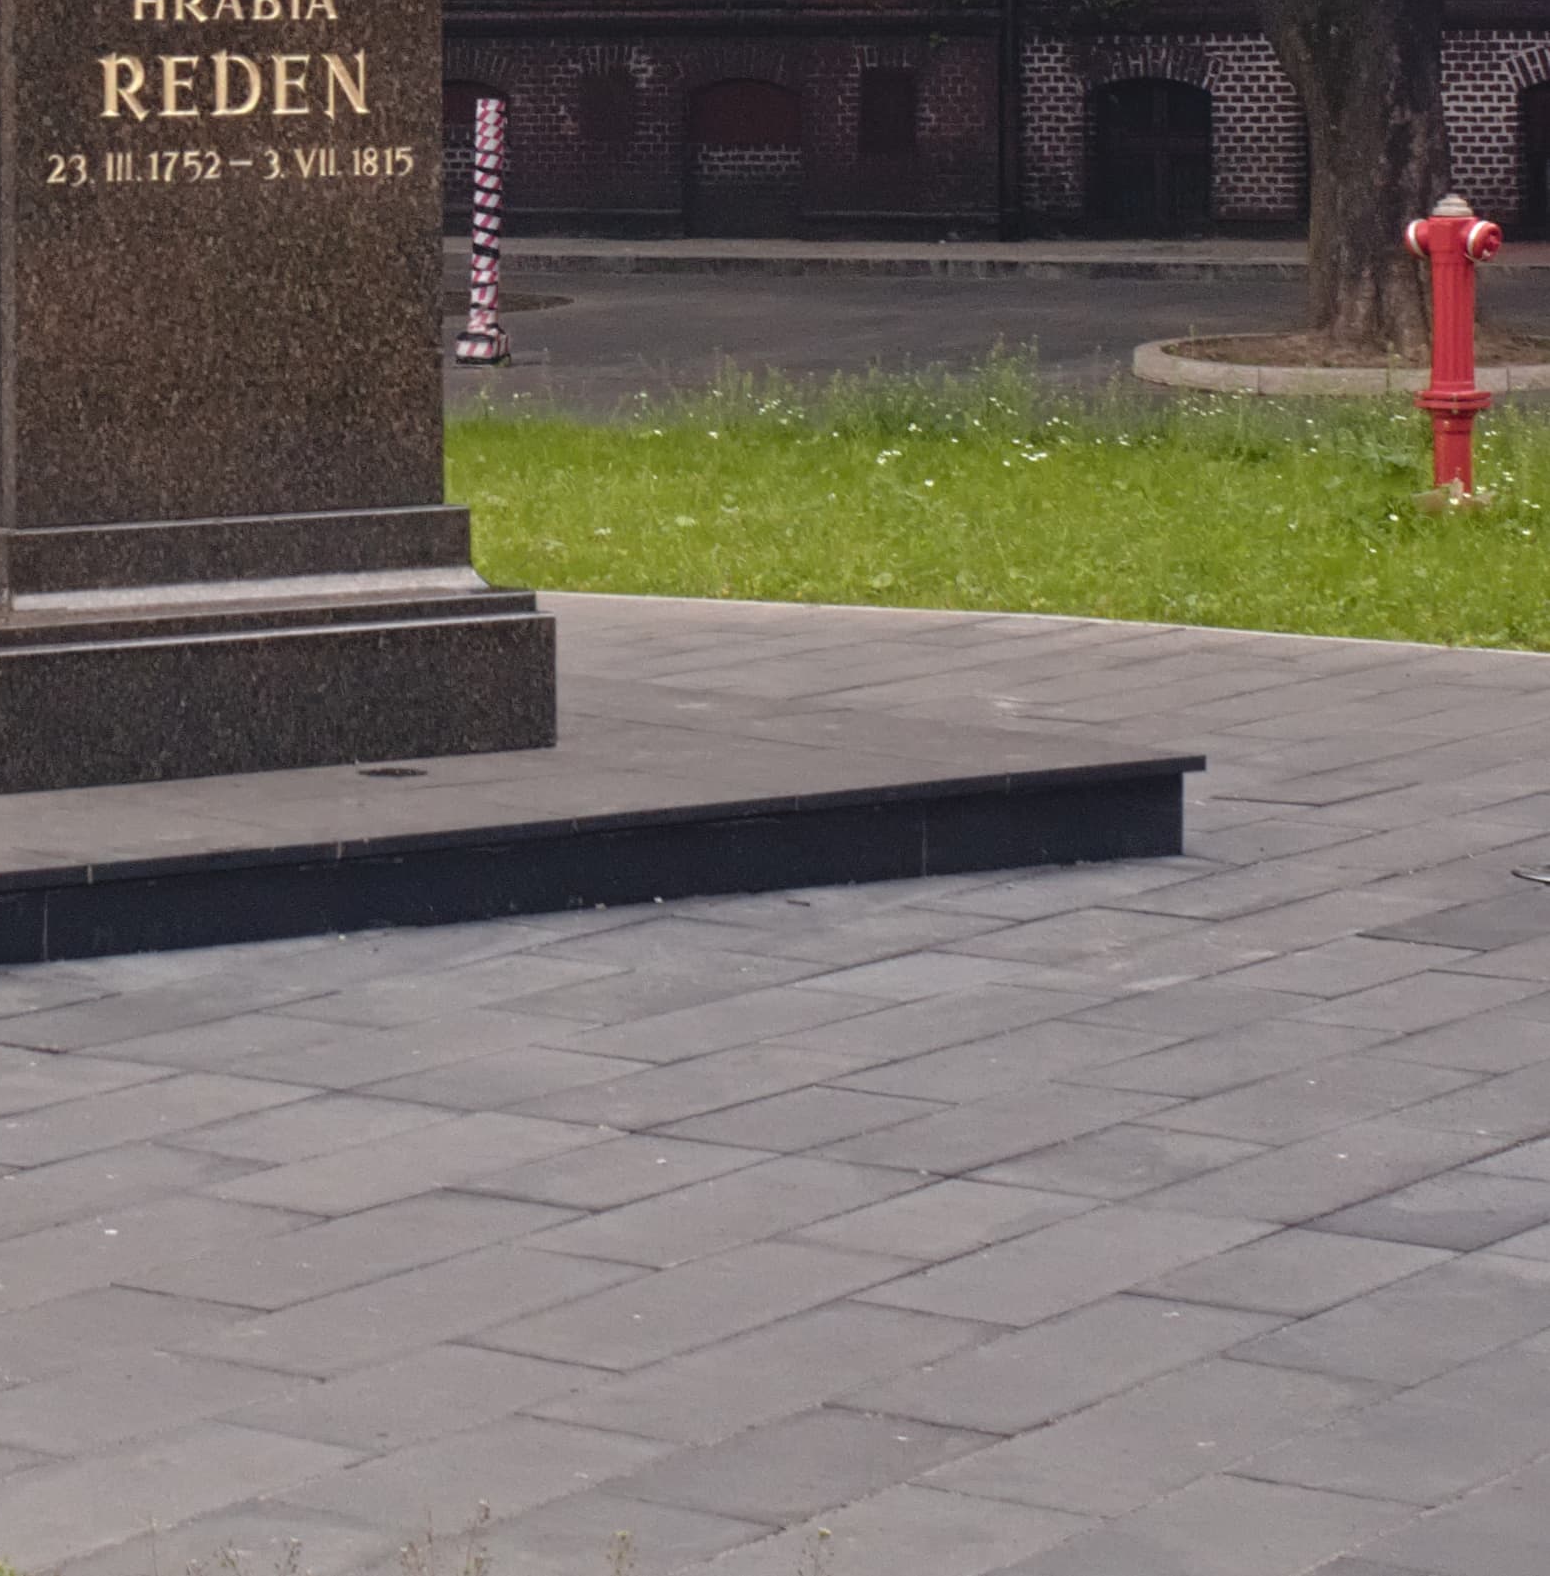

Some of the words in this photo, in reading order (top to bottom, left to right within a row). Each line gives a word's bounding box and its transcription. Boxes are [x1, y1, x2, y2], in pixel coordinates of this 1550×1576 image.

[98, 48, 371, 122] REDEN
[148, 150, 221, 183] 1752
[352, 146, 414, 177] 1815
